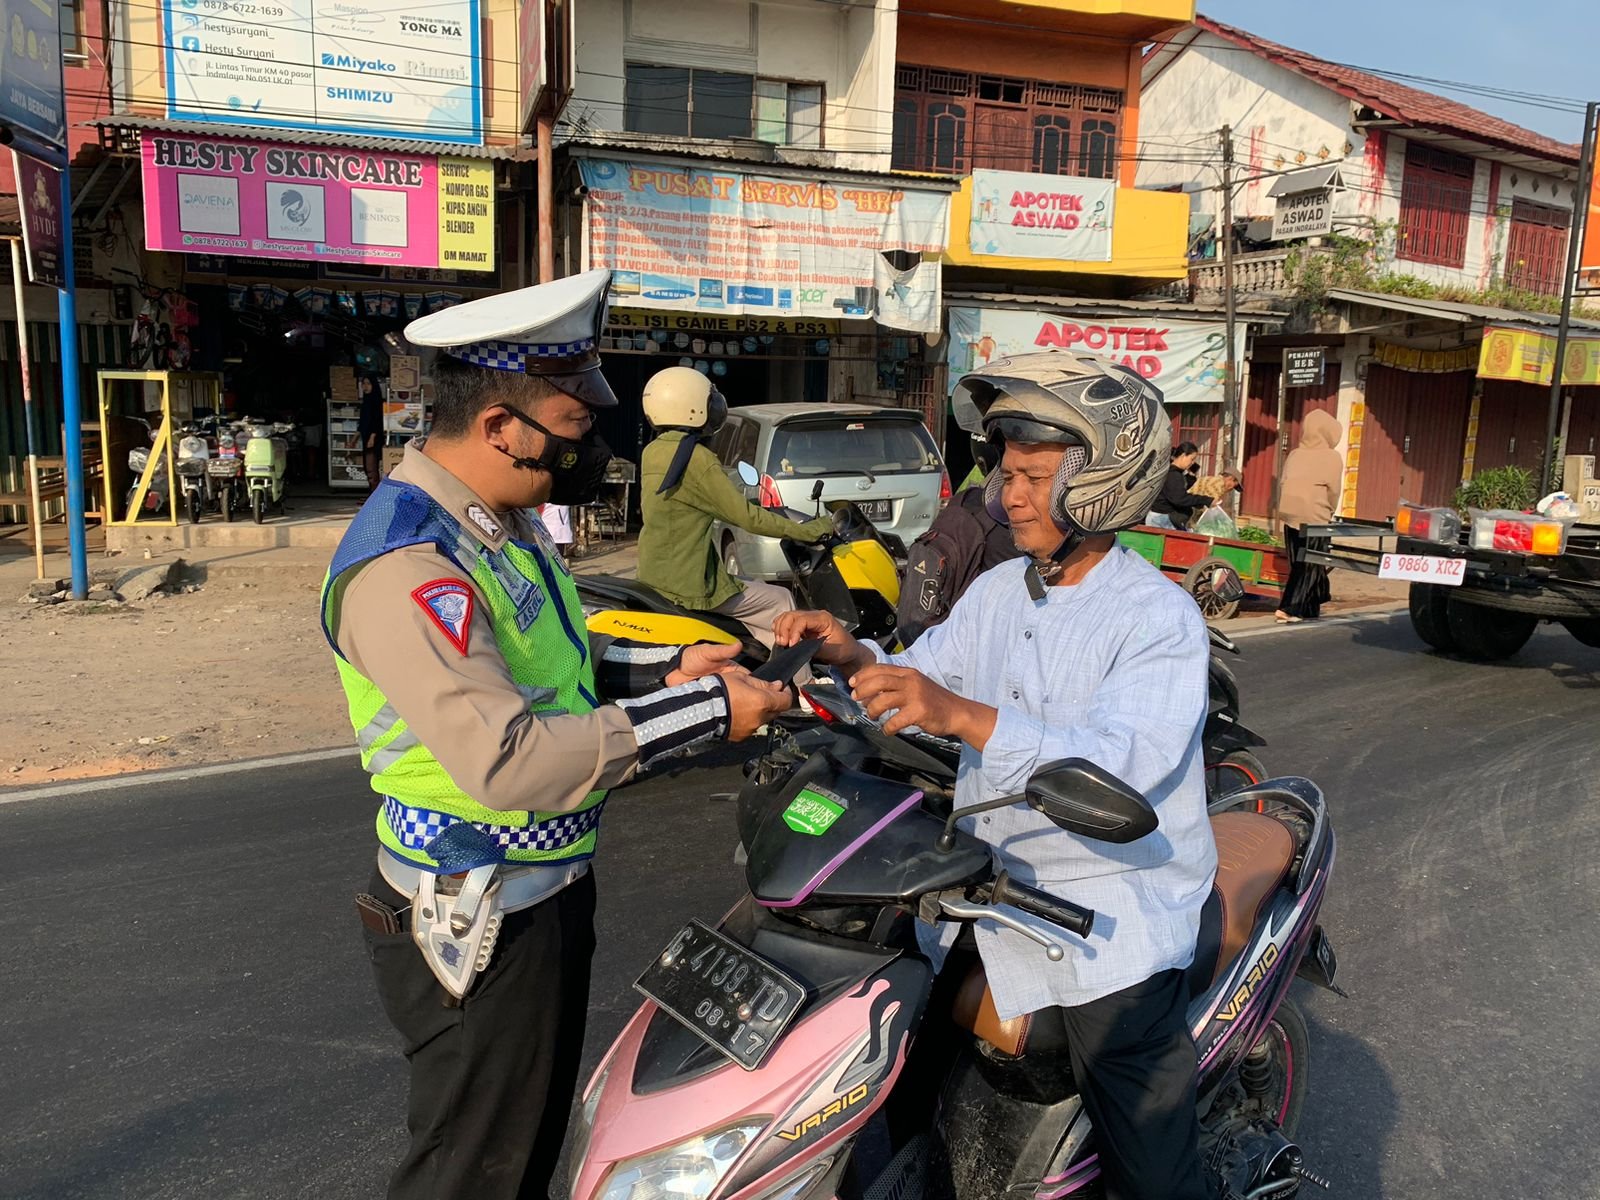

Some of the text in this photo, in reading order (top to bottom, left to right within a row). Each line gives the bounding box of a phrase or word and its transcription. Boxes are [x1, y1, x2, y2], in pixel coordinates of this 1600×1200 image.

[203, 1, 283, 16] 0878-6722-1639
[204, 22, 275, 39] hestysuryani_
[399, 21, 438, 34] YONG
[442, 26, 462, 37] MA
[205, 43, 275, 60] Hesty Suryani
[215, 62, 239, 71] Lintas
[241, 64, 263, 74] Timur
[264, 67, 278, 76] KM
[291, 70, 312, 79] pasar
[337, 55, 396, 73] Miyako
[326, 86, 393, 104] SHIMIZU
[153, 138, 423, 188] HESTY SKINCARE
[441, 163, 470, 178] SERVICE
[445, 183, 489, 199] KOMPOR GAS
[629, 168, 736, 200] PUSAT
[741, 178, 839, 211] SERVIS
[445, 201, 488, 217] KIPAS ANGIN
[1009, 190, 1084, 212] APOTEK
[1289, 191, 1330, 210] APOTEK
[1011, 210, 1080, 230] ASWAD
[1282, 208, 1324, 225] ASWAD
[32, 213, 57, 238] HYDE
[445, 220, 475, 234] BLENDER
[1275, 222, 1327, 235] PASAR INDRALAYA
[443, 250, 487, 263] OM MAMAT
[650, 290, 691, 299] SAMSUNG
[796, 287, 828, 303] acer
[644, 315, 668, 328] ISI
[676, 316, 729, 330] GAME
[736, 319, 769, 333] PS2
[776, 321, 788, 334] &
[795, 322, 827, 335] PS3
[1034, 321, 1170, 352] APOTEK
[1288, 351, 1321, 359] PENJAHIT
[1294, 359, 1315, 368] HER
[1383, 556, 1391, 570] B
[1435, 559, 1462, 576] XRZ
[613, 619, 654, 634] NMAX
[690, 943, 749, 993] 4139
[747, 975, 791, 1022] TD
[1215, 941, 1280, 1021] VARIO
[776, 1082, 868, 1142] VARIO
